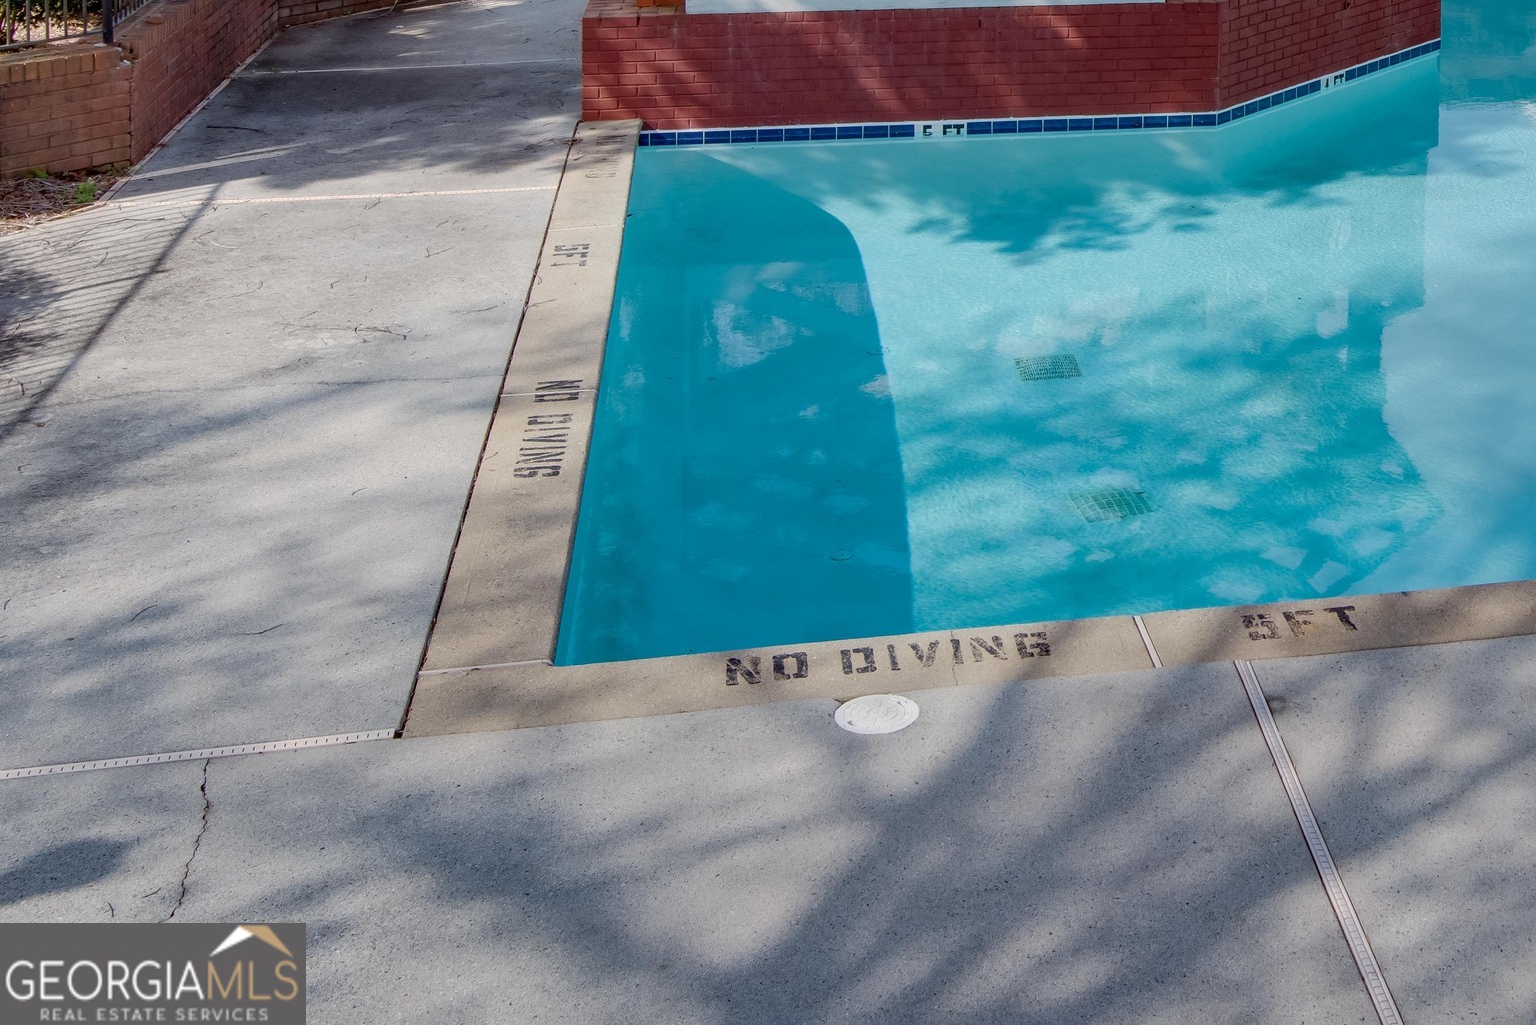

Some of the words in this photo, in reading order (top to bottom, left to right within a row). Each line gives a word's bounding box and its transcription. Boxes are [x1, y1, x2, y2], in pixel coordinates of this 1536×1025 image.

[922, 124, 933, 137] 5
[942, 124, 965, 136] FT
[534, 379, 584, 403] NO
[513, 413, 574, 478] DIVING
[725, 649, 809, 687] NO
[840, 631, 1051, 675] DIVING
